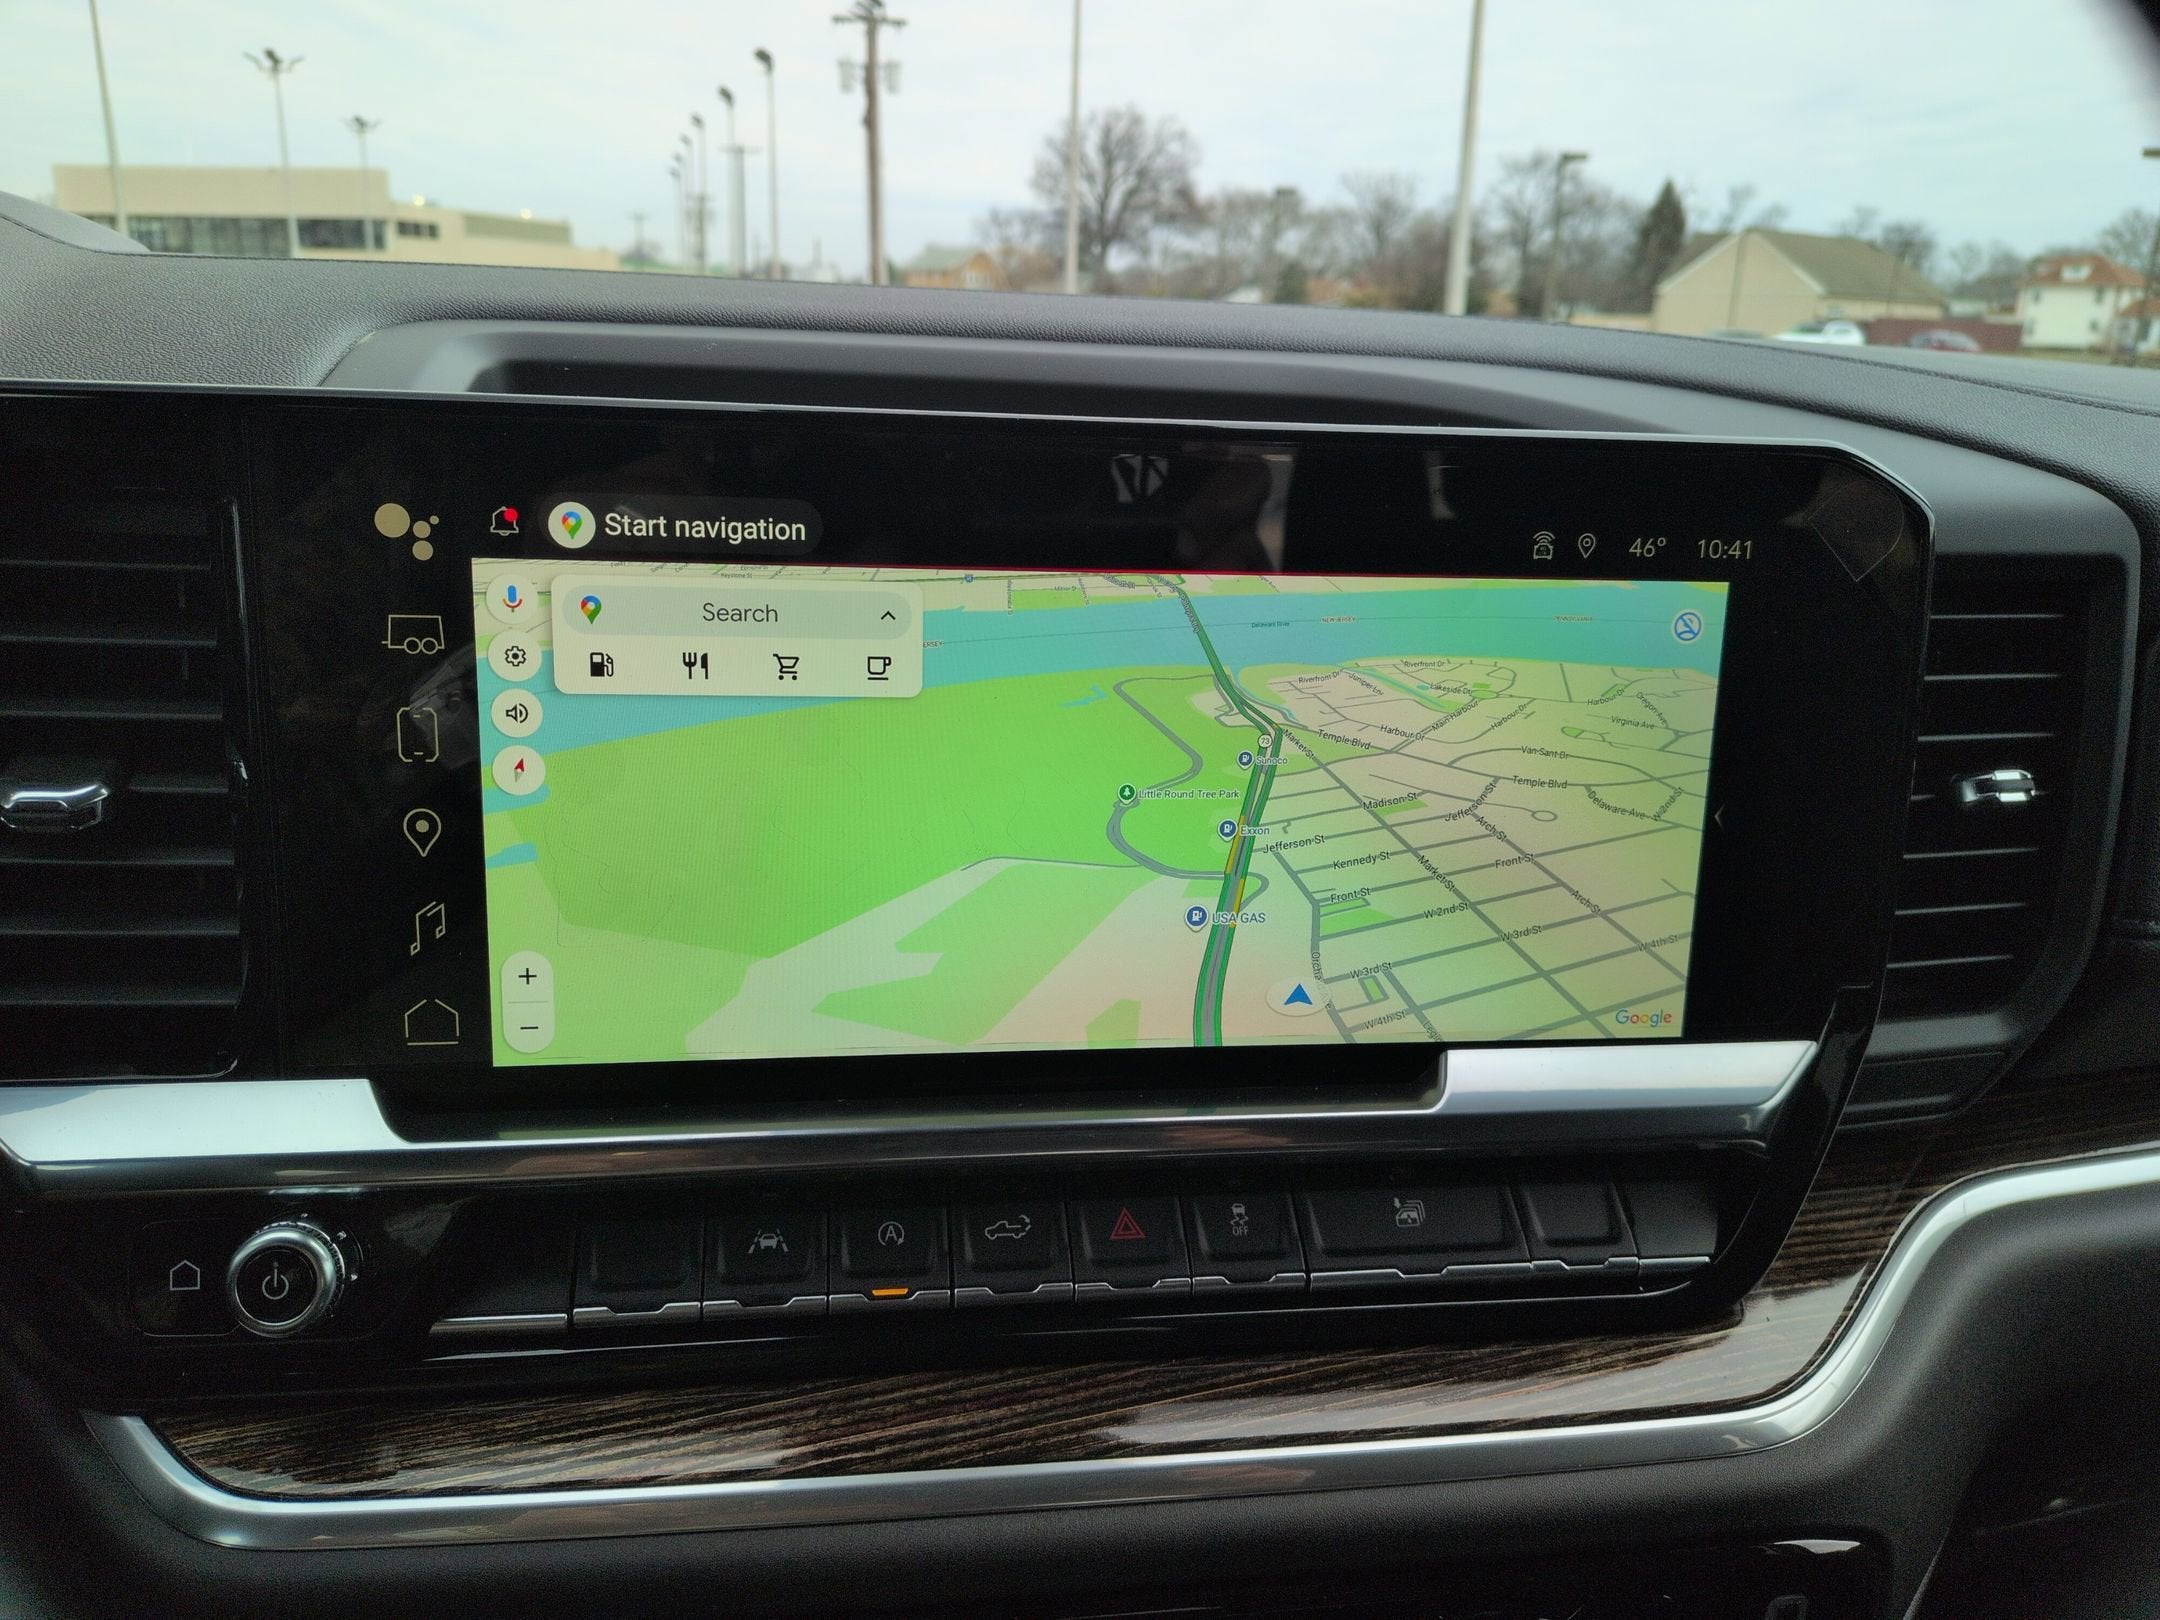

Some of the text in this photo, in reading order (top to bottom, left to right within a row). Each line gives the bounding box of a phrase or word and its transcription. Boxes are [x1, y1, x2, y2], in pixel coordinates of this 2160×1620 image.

[604, 512, 806, 545] Start navigation
[1629, 537, 1667, 558] 46°
[1698, 539, 1752, 560] 10:41
[702, 603, 779, 624] Search
[1404, 660, 1436, 669] Riverfront
[1298, 674, 1332, 684] Riverfront
[1349, 673, 1374, 690] Juniper
[1430, 683, 1461, 695] Lakeside
[1587, 687, 1625, 706] Harbour Dr
[1432, 701, 1479, 732] Main Harbour
[1490, 702, 1528, 730] Harbour Dr
[1636, 692, 1667, 726] Oregon Ave
[1611, 715, 1655, 730] Virginia Ave
[1261, 737, 1270, 745] 73
[1318, 728, 1371, 750] Temple Blvd
[1380, 724, 1425, 742] Harbour Dr
[1283, 729, 1314, 759] Market St
[1521, 745, 1569, 760] Van Sant Dr
[1256, 756, 1288, 765] Sunoco
[1512, 775, 1567, 789] Temple Blvd
[1139, 789, 1240, 799] Little Round Tree Park
[1363, 791, 1418, 811] Madison St
[1445, 781, 1496, 823] Jefferson St
[1588, 790, 1647, 820] Delaware Ave
[1240, 826, 1270, 836] Exxon
[1476, 815, 1507, 842] Arch St
[1262, 834, 1325, 855] Jefferson St
[1333, 851, 1391, 870] Kennedy St
[1495, 852, 1535, 869] Front St
[1418, 855, 1456, 892] Market St
[1330, 886, 1371, 904] Front St
[1571, 889, 1601, 915] Arch St
[1212, 912, 1266, 924] USA GAS
[1423, 902, 1469, 920] W 2nd St
[1500, 924, 1542, 942] W 3rd St
[1637, 933, 1679, 952] W 4th St
[1350, 961, 1392, 979] W 3rd St
[1363, 1010, 1406, 1030] W 4th St
[1615, 1008, 1673, 1028] Google
[1232, 1225, 1249, 1237] OFF
